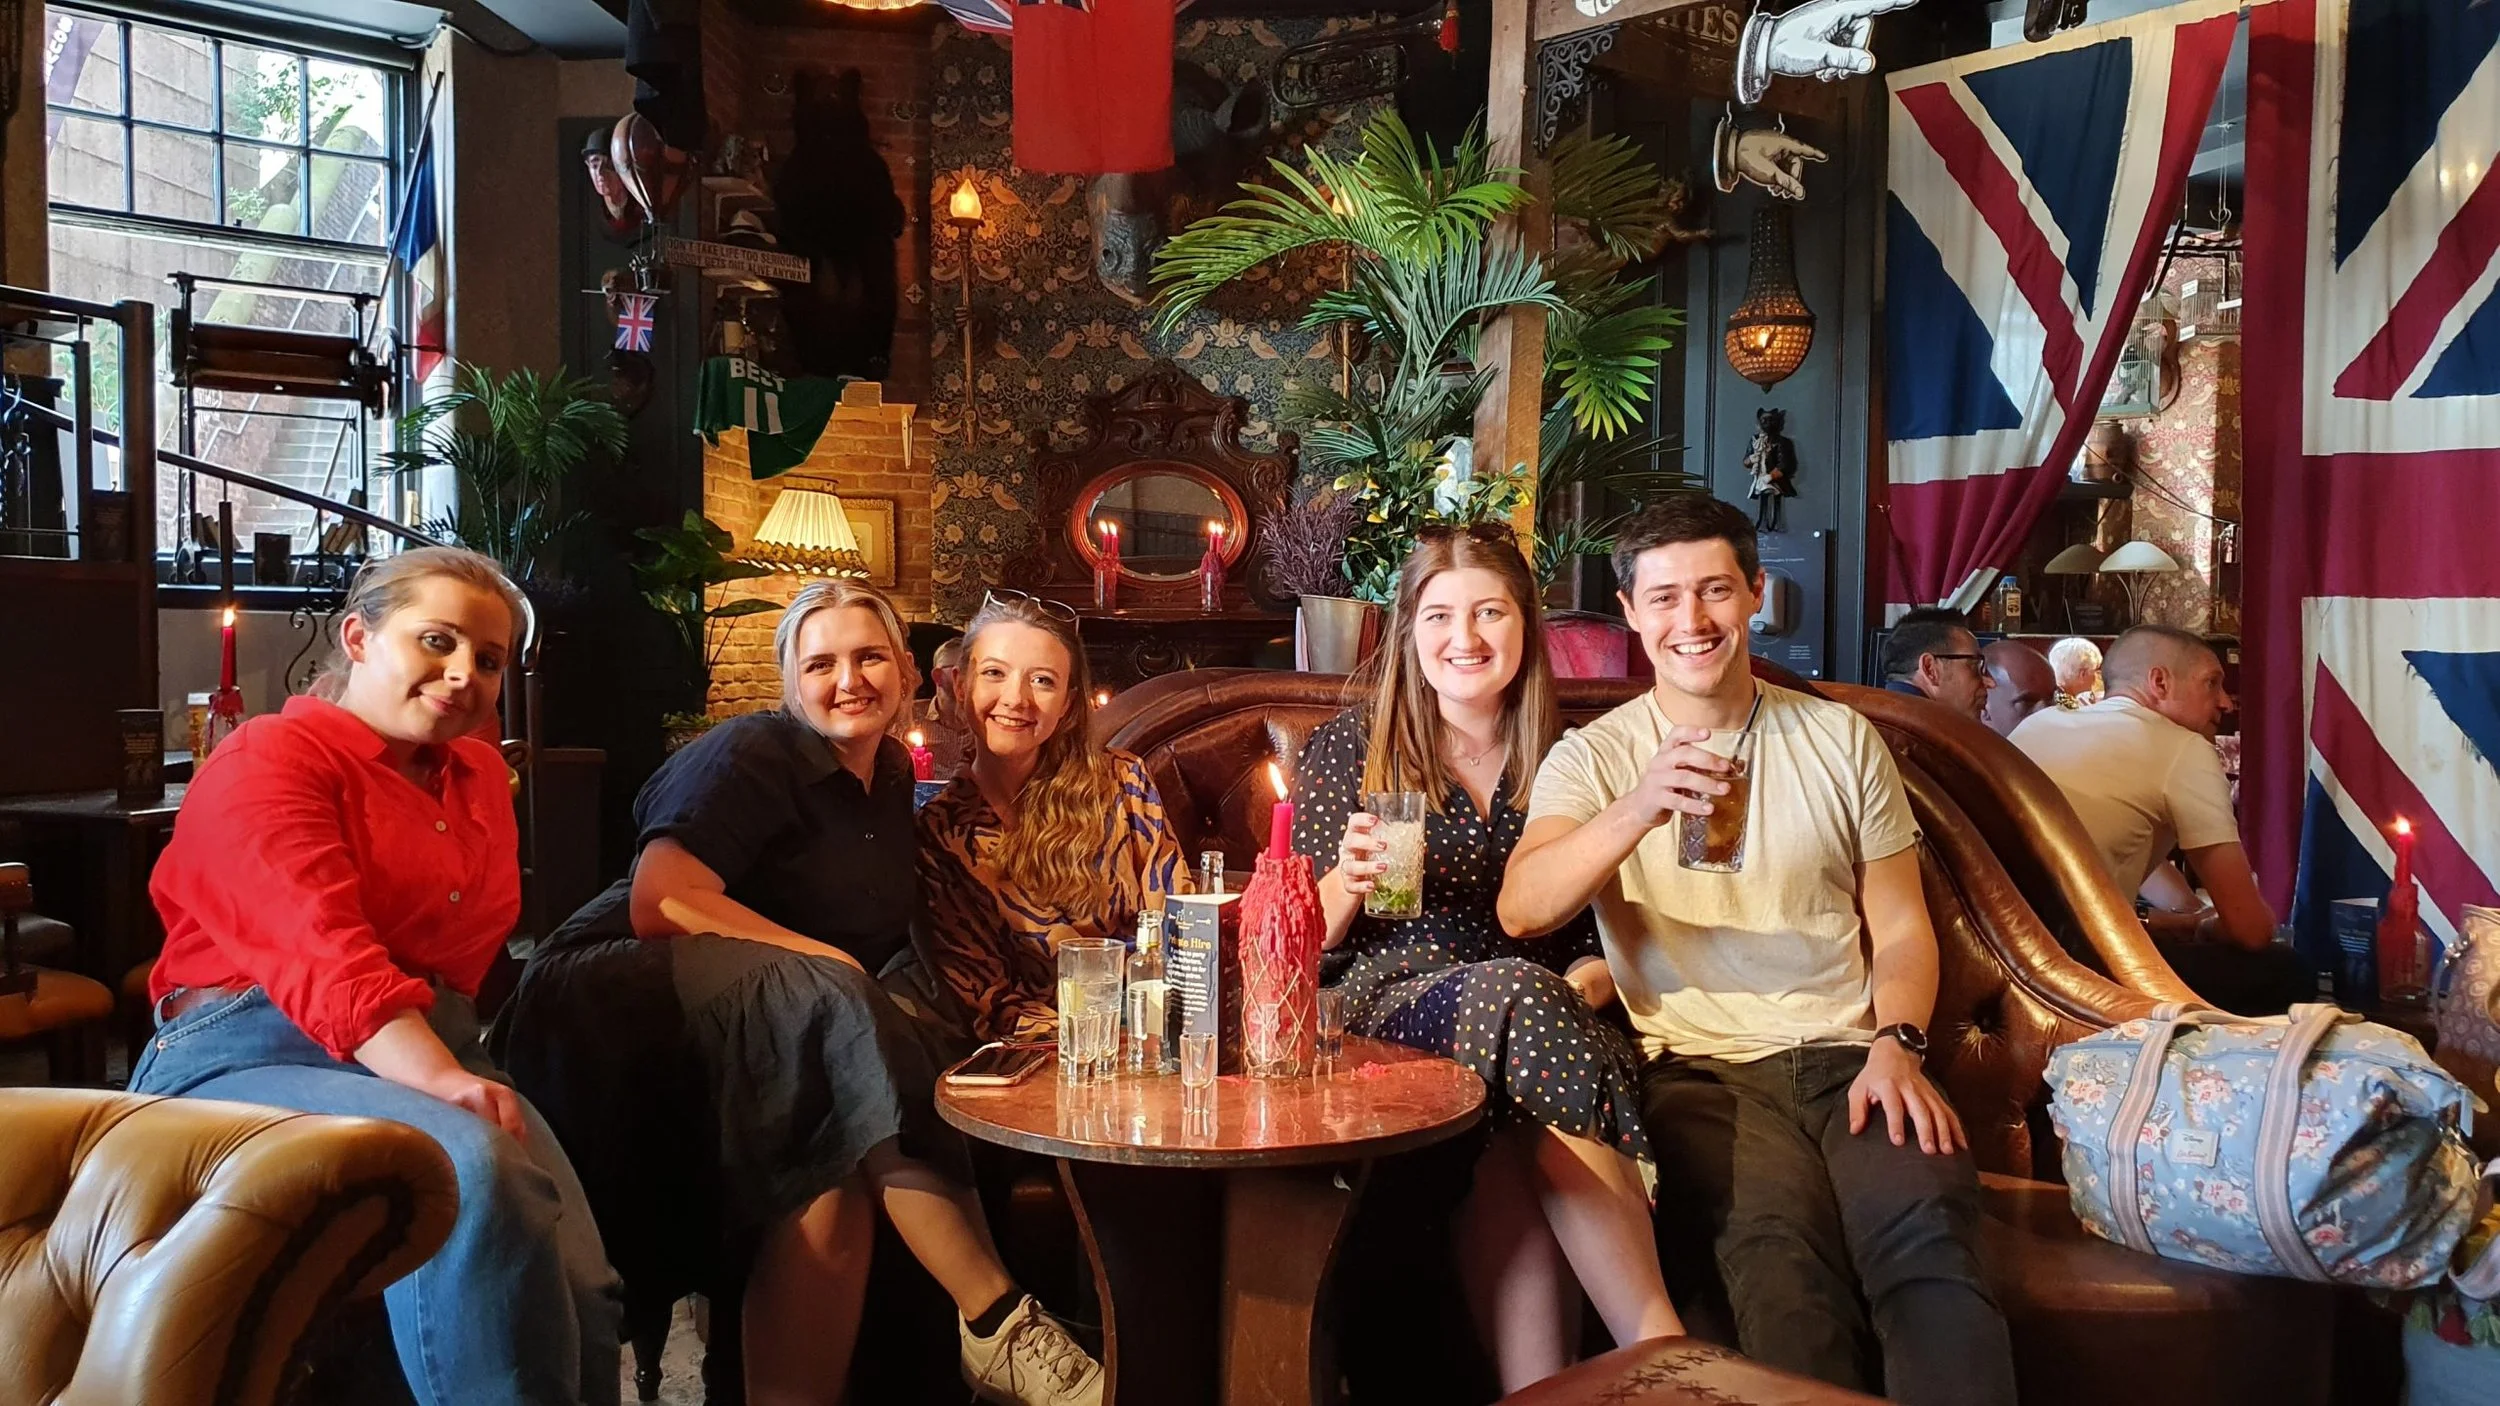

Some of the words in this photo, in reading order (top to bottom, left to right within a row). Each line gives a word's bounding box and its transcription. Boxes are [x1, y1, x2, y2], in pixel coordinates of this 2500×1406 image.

[668, 250, 702, 265] NOBODY
[704, 256, 726, 268] GETS
[728, 260, 744, 271] OUT
[748, 262, 770, 276] ALIVE
[773, 266, 808, 282] ANYWAY
[697, 244, 719, 256] TAKE
[720, 246, 739, 258] LIFE
[742, 248, 759, 261] TOO
[761, 251, 808, 268] SERIOUSLY
[730, 357, 787, 393] BEST
[744, 386, 784, 435] 11
[1190, 937, 1212, 950] Hire
